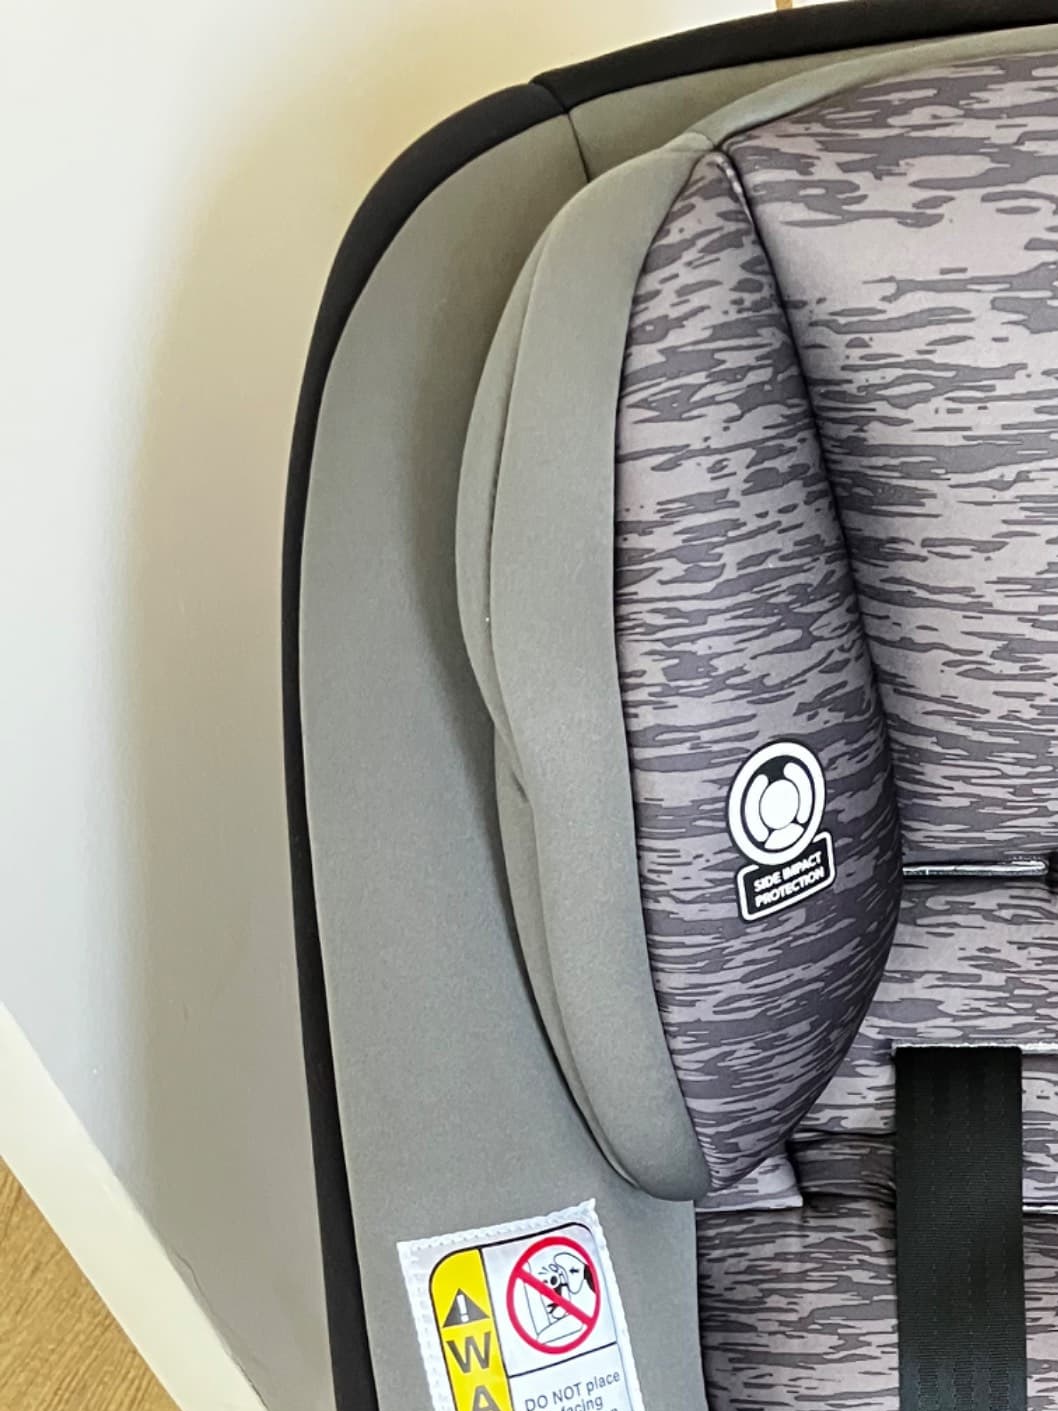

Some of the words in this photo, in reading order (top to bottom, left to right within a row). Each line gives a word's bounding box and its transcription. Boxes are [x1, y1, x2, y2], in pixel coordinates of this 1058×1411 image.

[753, 872, 782, 892] SIDE
[782, 851, 822, 881] IMPACT
[755, 867, 825, 907] PROTECTION
[525, 1394, 549, 1411] DO
[552, 1382, 582, 1405] NOT
[586, 1371, 620, 1395] place
